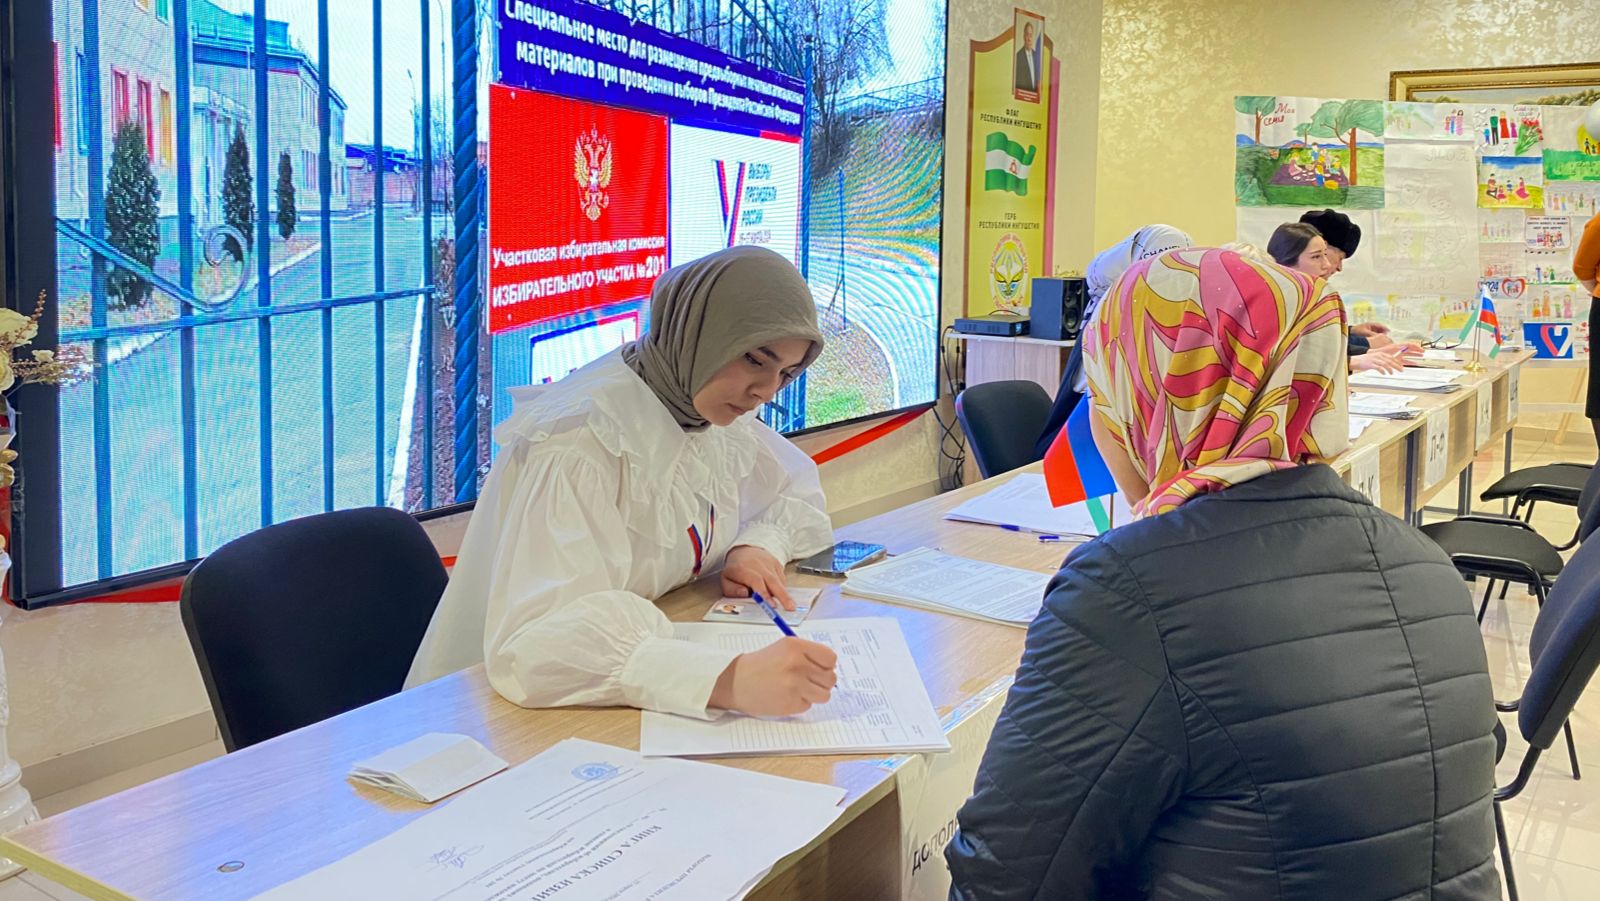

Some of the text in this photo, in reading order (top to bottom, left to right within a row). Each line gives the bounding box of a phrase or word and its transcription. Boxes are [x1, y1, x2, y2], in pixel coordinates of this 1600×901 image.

[505, 0, 595, 44] Специальное
[596, 27, 628, 54] место
[629, 38, 647, 60] для
[516, 40, 595, 78] материалов
[597, 61, 619, 88] при
[618, 67, 673, 98] проведении
[980, 113, 1013, 126] РЕСПУБЛИКИ
[1006, 108, 1020, 117] ФЛАГ
[979, 221, 1012, 229] РЕСПУБЛИКИ
[1004, 212, 1017, 221] ГЕРБ
[493, 236, 665, 269] Участковая избирательная комиссия
[492, 270, 595, 308] ИЗБИРАТЕЛЬНОГО
[595, 263, 635, 287] УЧАСТКА
[620, 824, 662, 849] КНИГА
[570, 849, 623, 880] СПИСКА
